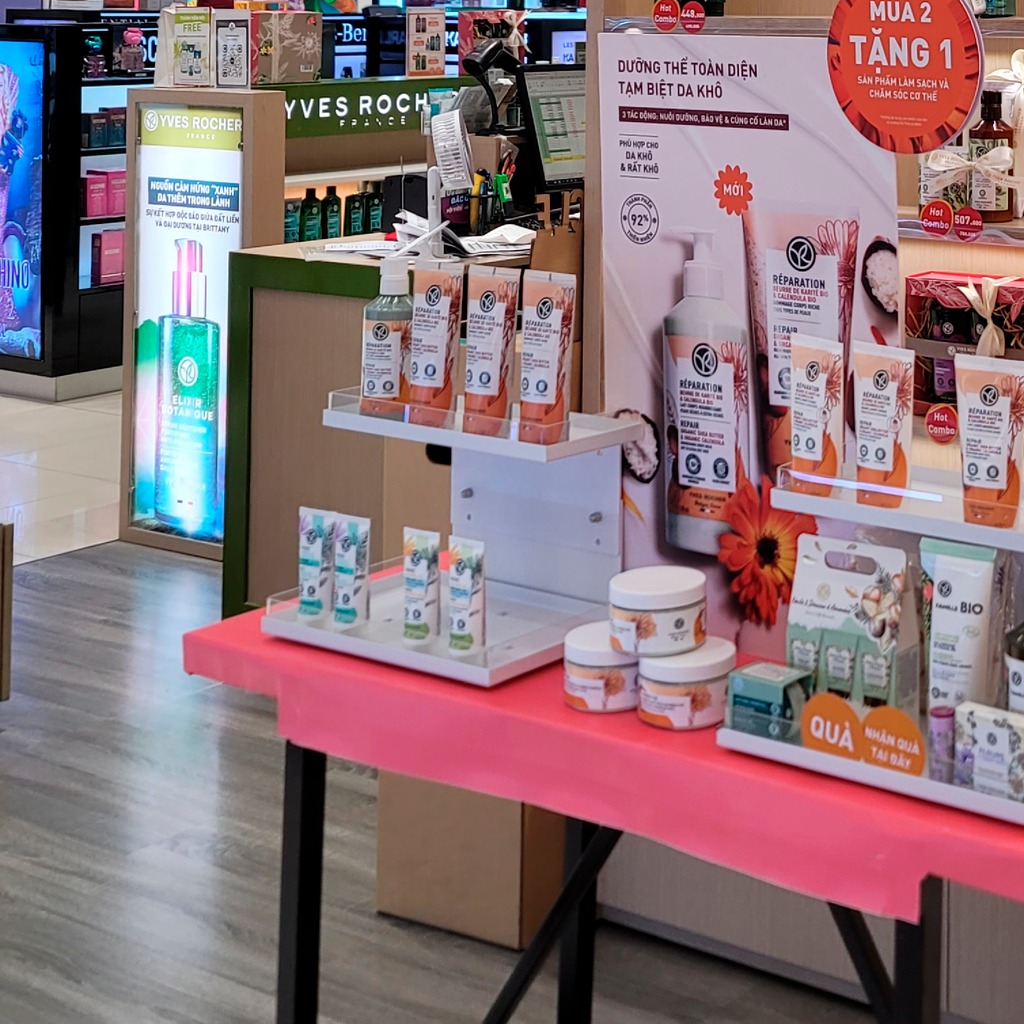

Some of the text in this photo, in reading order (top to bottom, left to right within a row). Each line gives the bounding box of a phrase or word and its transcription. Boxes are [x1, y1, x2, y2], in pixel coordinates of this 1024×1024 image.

[660, 4, 672, 12] Hot
[869, 0, 932, 23] MUA 2
[655, 14, 677, 23] Combo
[183, 23, 202, 32] FREE
[849, 27, 952, 74] TẶNG 1
[618, 56, 758, 81] DƯỠNG THỂ TOÀN DIỆN
[857, 73, 950, 90] SẢN PHẨM LÀM SẠCH VÀ
[618, 79, 723, 99] TẠM BIỆT DA KHÔ
[869, 88, 938, 102] CHĂM SÓC CƠ THỂ
[285, 96, 348, 119] YVES
[159, 115, 242, 132] YVES ROCHER
[340, 116, 406, 127] FRANCE
[627, 111, 639, 119] TÁC
[660, 112, 675, 121] NUÔI
[715, 114, 723, 124] VỆ
[725, 116, 730, 124] &
[187, 132, 216, 140] FRANCE
[619, 139, 659, 150] PHÙ HỢP CHO
[625, 150, 653, 161] DA KHÔ
[620, 161, 659, 174] & RẤT KHÔ
[723, 181, 744, 196] MỚI
[929, 207, 943, 217] Hot
[631, 214, 649, 226] 92%
[923, 219, 949, 230] Combo
[773, 273, 825, 289] RÉPARATION
[680, 378, 722, 393] RÉPARATION
[172, 394, 202, 409] ELIXIR
[934, 412, 949, 422] Hot
[969, 407, 1002, 417] RÉPARATION
[928, 424, 955, 435] Combo
[960, 601, 983, 615] BIO
[810, 715, 855, 753] QUÀ
